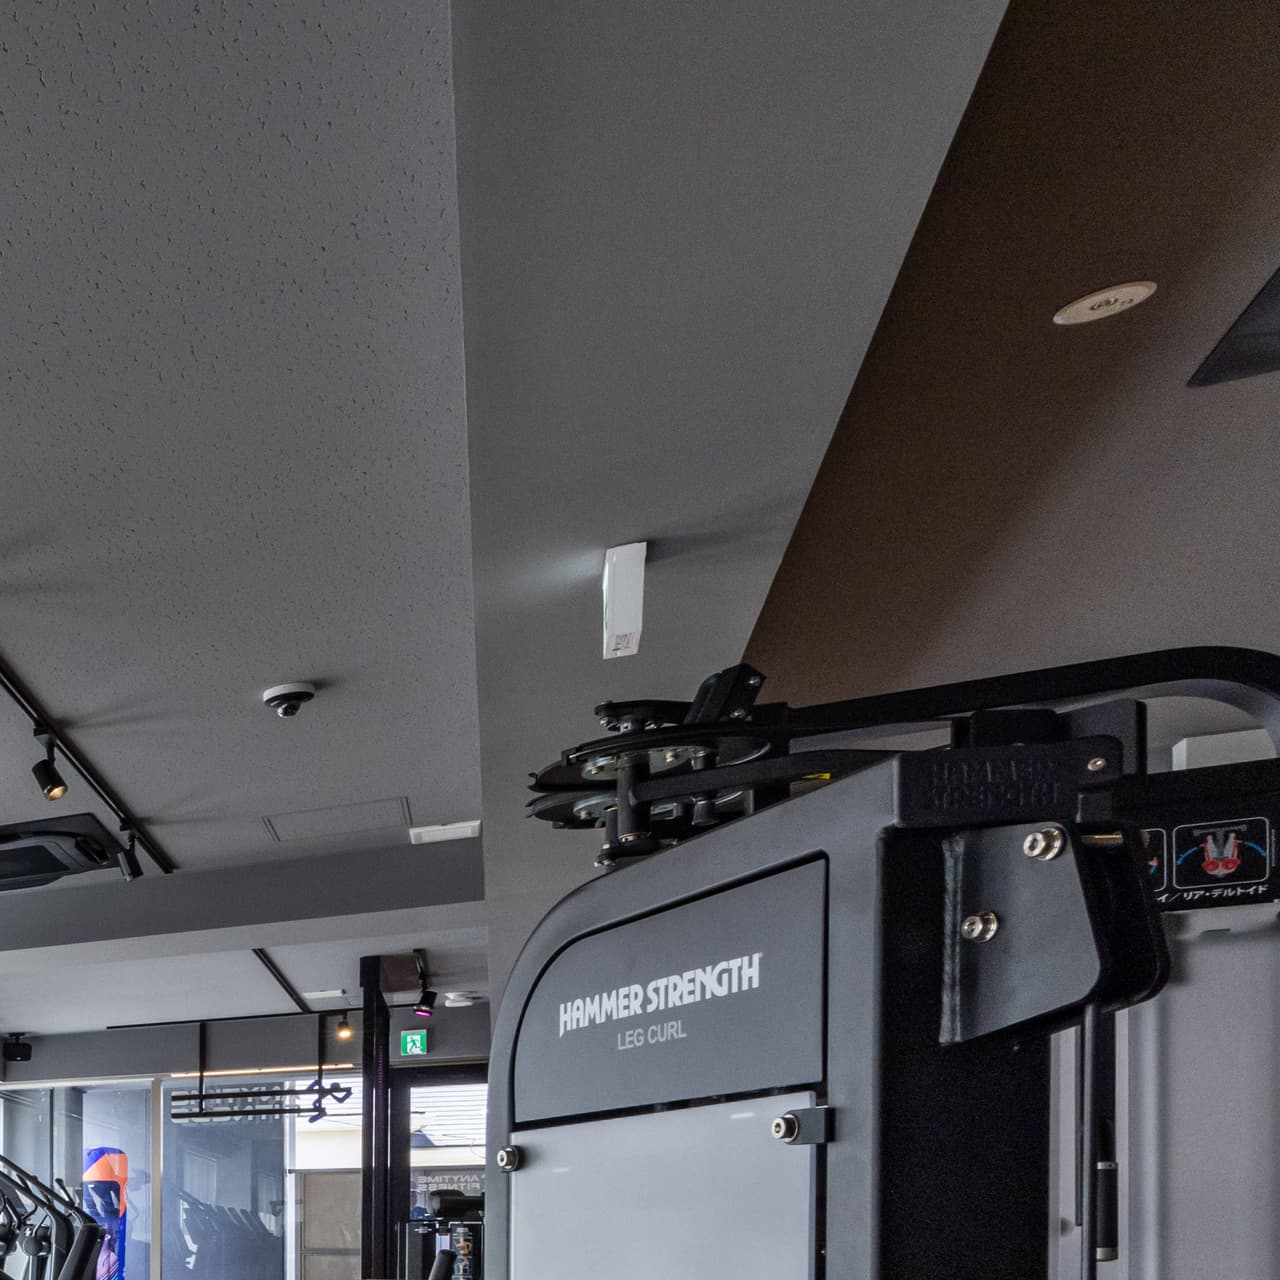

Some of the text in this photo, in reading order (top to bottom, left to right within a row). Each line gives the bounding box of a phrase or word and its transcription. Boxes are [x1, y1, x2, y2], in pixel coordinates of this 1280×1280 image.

[559, 953, 760, 1039] HAMMER STRENGTH
[617, 1020, 687, 1050] LEG CURL
